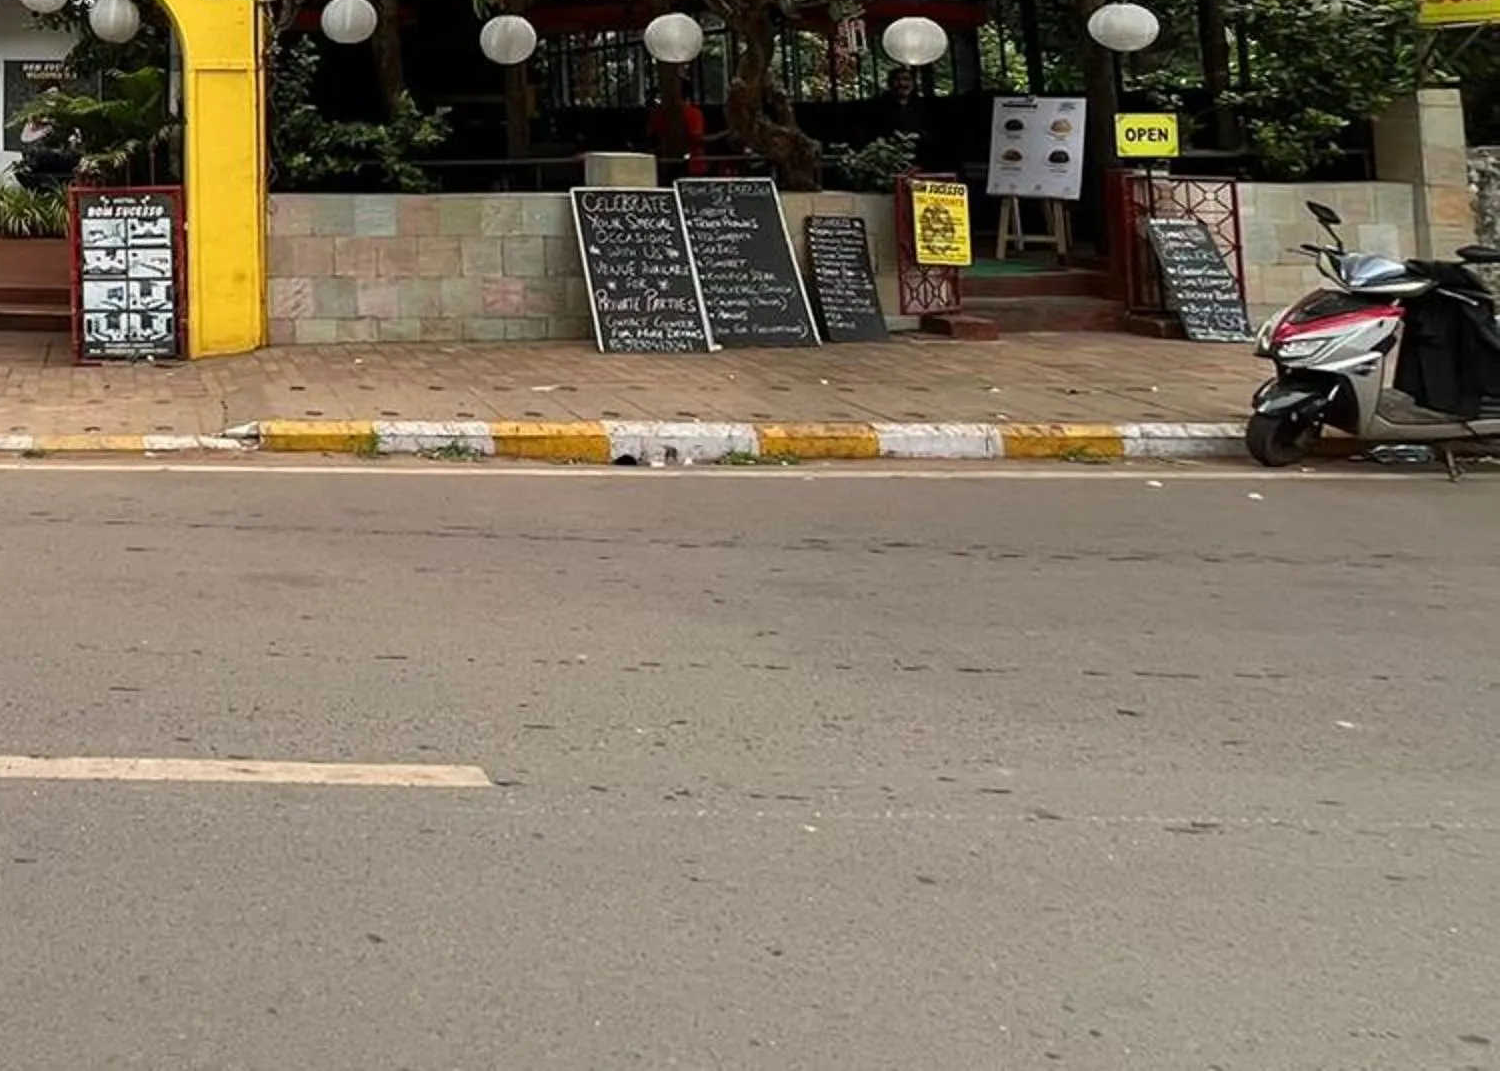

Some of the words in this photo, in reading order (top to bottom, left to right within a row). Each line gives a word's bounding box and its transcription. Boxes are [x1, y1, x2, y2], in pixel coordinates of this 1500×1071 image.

[1125, 127, 1169, 142] OPEN
[581, 192, 672, 213] CELEBRATE
[643, 289, 697, 312] PARTIES
